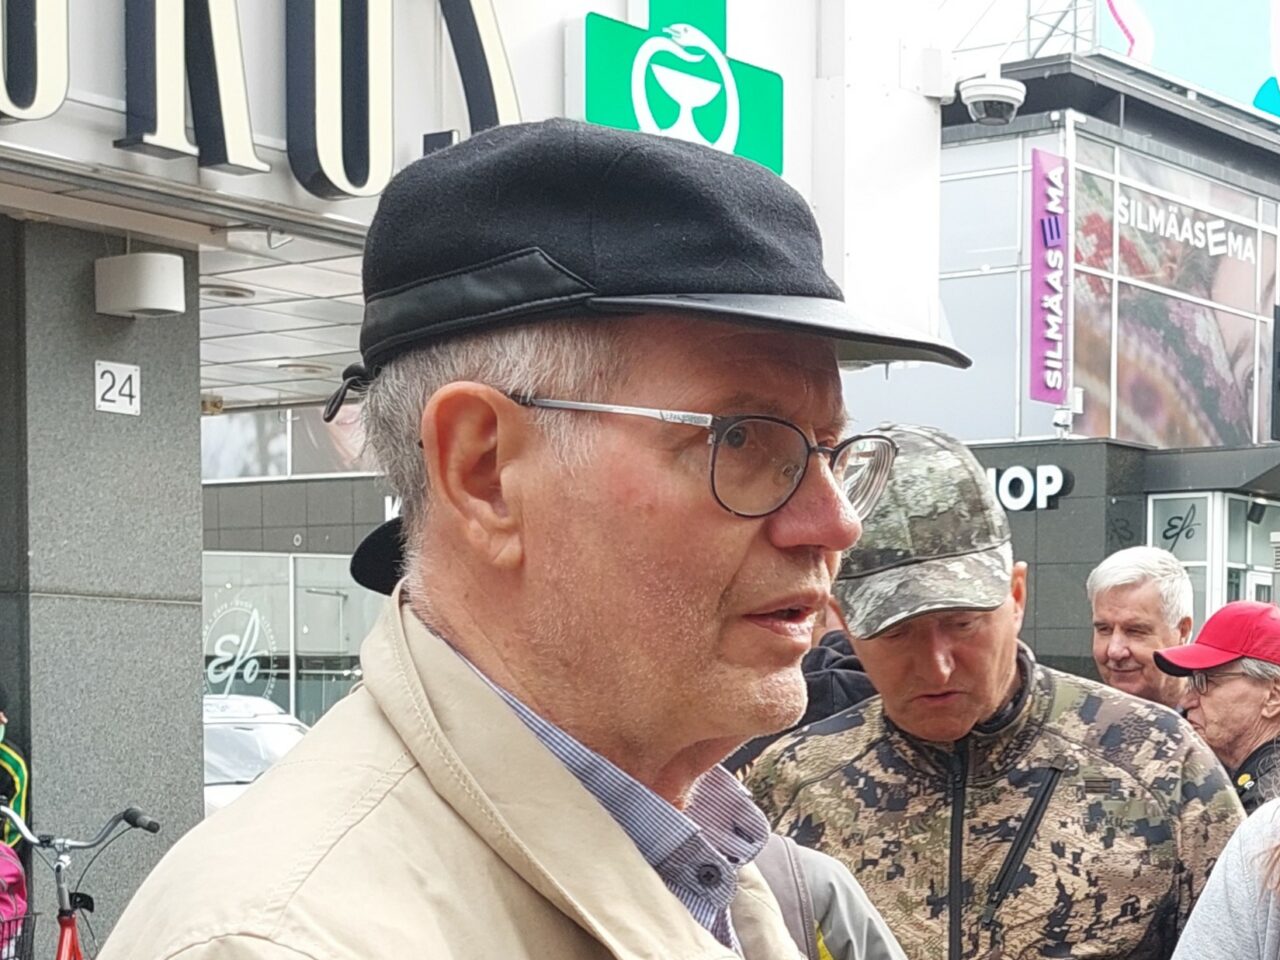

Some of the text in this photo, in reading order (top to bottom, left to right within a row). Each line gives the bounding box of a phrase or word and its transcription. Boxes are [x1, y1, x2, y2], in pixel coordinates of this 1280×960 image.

[1118, 195, 1256, 265] SILMÄASEMA
[1040, 165, 1065, 391] SILMÄASEMA
[100, 369, 136, 406] 24
